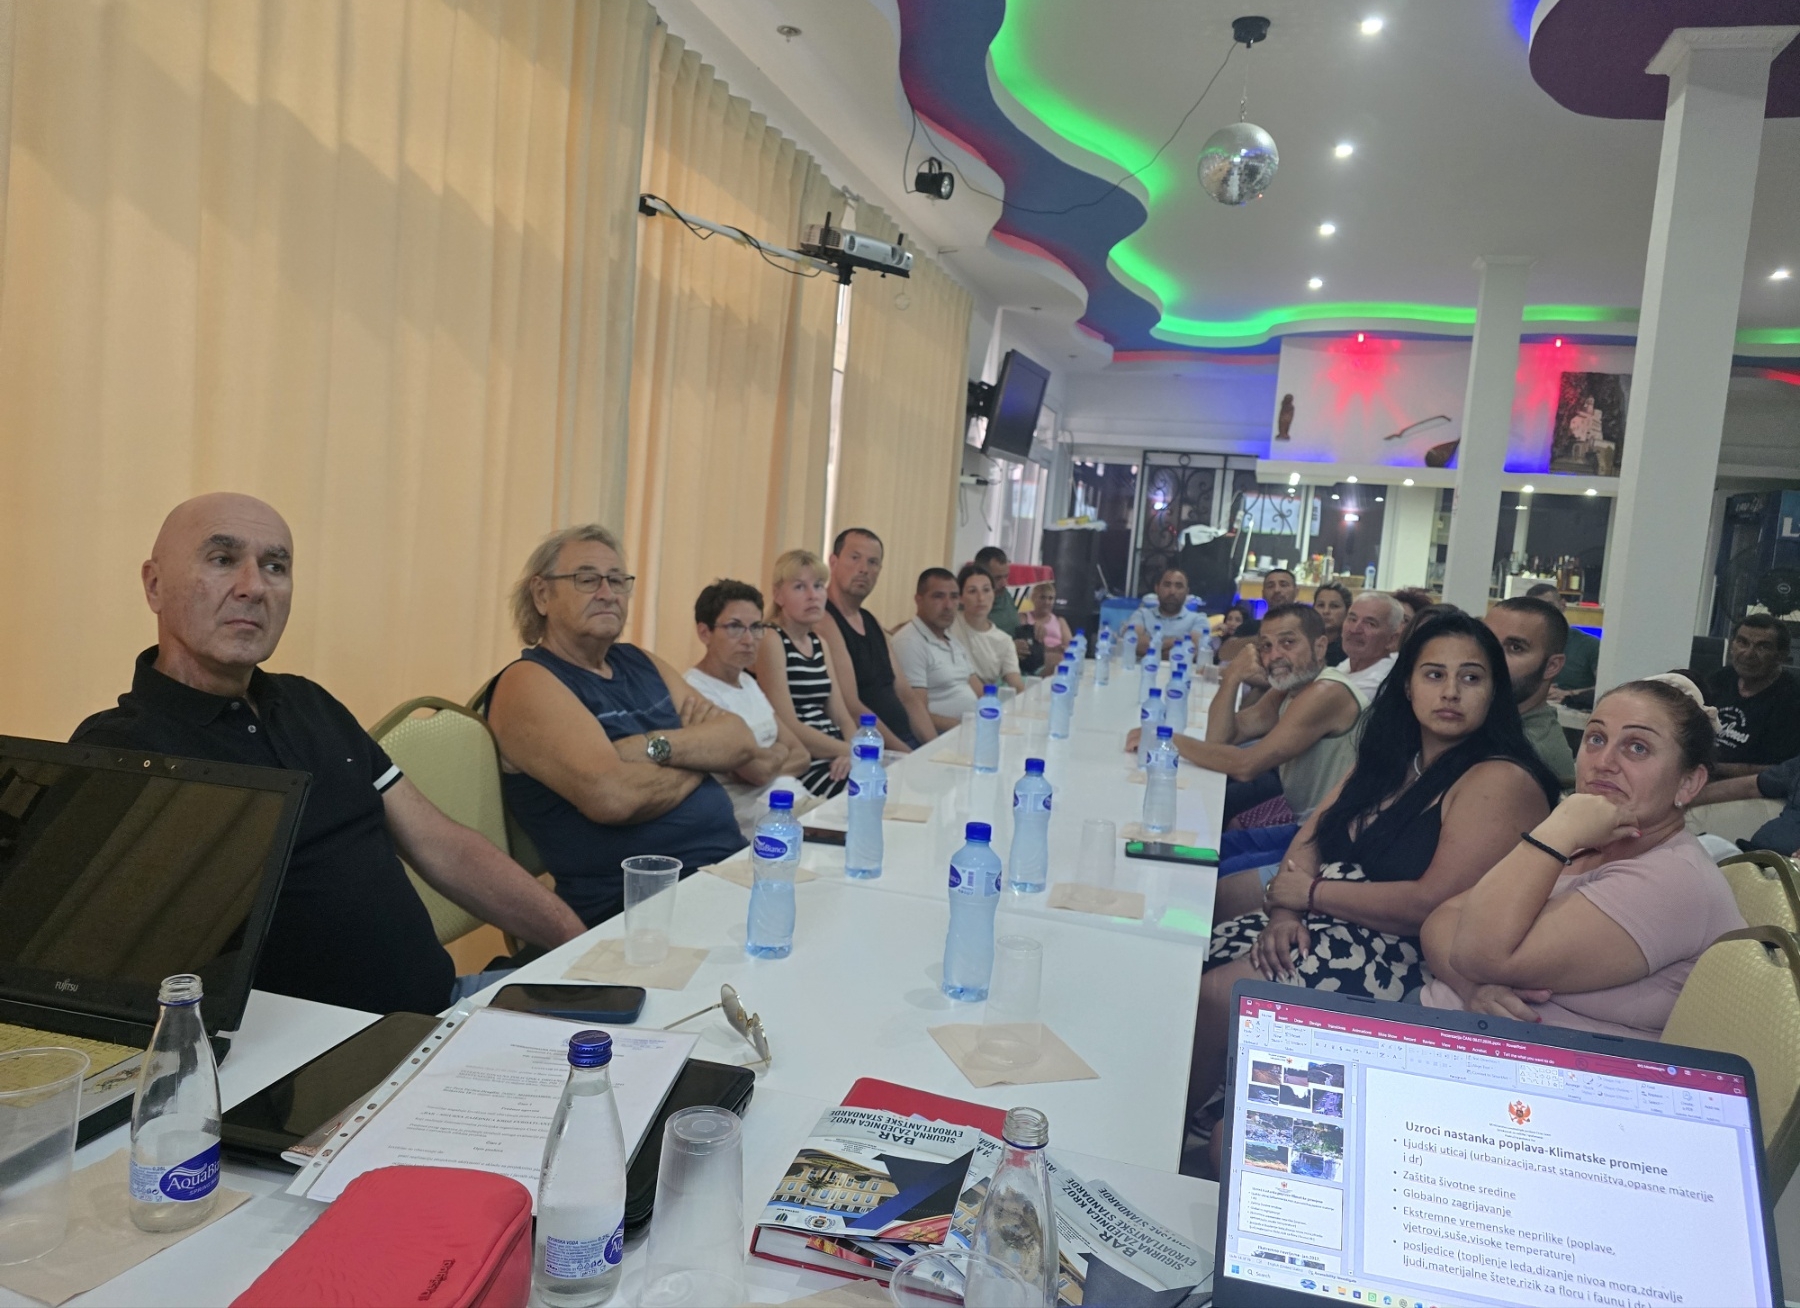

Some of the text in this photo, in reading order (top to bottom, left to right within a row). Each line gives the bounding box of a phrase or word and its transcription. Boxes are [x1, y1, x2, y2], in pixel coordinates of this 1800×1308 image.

[55, 979, 78, 992] FUJITSU
[830, 1110, 964, 1138] EVROATLANTSKE STANDARDE
[830, 1116, 957, 1144] SIGURNA ZAJEDNICA KROZ
[878, 1131, 915, 1145] BAR
[1405, 1121, 1441, 1136] Uzroci
[1444, 1129, 1495, 1146] nastanka
[1499, 1139, 1606, 1165] poplava-Klimatske
[1610, 1158, 1668, 1176] promjene
[1408, 1153, 1423, 1166] dr)
[166, 1160, 220, 1192] AquaBia
[1403, 1138, 1714, 1202] Ljudski uticaj (urbanizacija,rast stanovništva,opasne materije
[1403, 1170, 1436, 1185] Zaštita
[1479, 1186, 1516, 1200] sredine
[1061, 1185, 1088, 1209] KROZ
[1065, 1177, 1117, 1221] STANDARDE
[1098, 1187, 1149, 1227] STANDARDE
[1403, 1188, 1512, 1217] Globalno zagrijavanje
[1086, 1207, 1139, 1247] ZAJEDNICA
[1402, 1221, 1575, 1264] vjetrovi,suše,visoke temperature)
[1403, 1206, 1616, 1256] Ekstremne vremenske neprilike (poplave,
[1098, 1230, 1139, 1258] BAR
[1114, 1219, 1198, 1267] EVROATLANTSKE
[1138, 1241, 1184, 1271] SIGURNA
[1255, 1271, 1271, 1279] Search
[1403, 1241, 1683, 1304] posljedice (topljenje leda,dizanje nivoa mora,zdravlje
[1403, 1254, 1488, 1280] ljudi,materijalne
[1490, 1271, 1542, 1291] štete,rizik
[1544, 1285, 1556, 1293] za
[1559, 1285, 1584, 1299] floru
[1594, 1291, 1625, 1308] faunu
